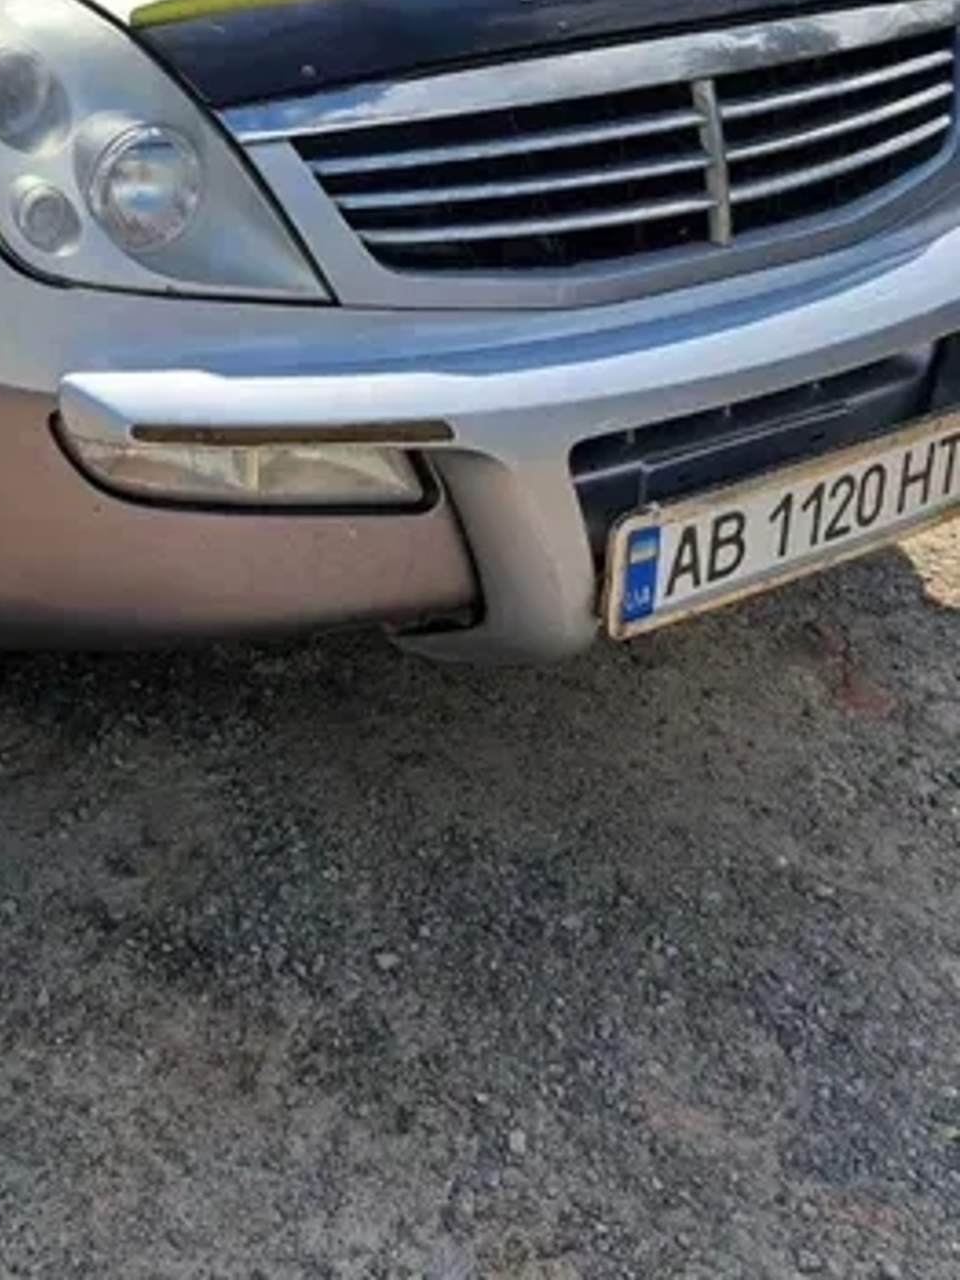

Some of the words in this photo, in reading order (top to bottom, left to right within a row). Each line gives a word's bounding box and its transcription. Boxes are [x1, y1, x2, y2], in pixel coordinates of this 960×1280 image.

[665, 511, 746, 596] AB
[769, 463, 887, 557] 1120
[897, 433, 960, 514] HT
